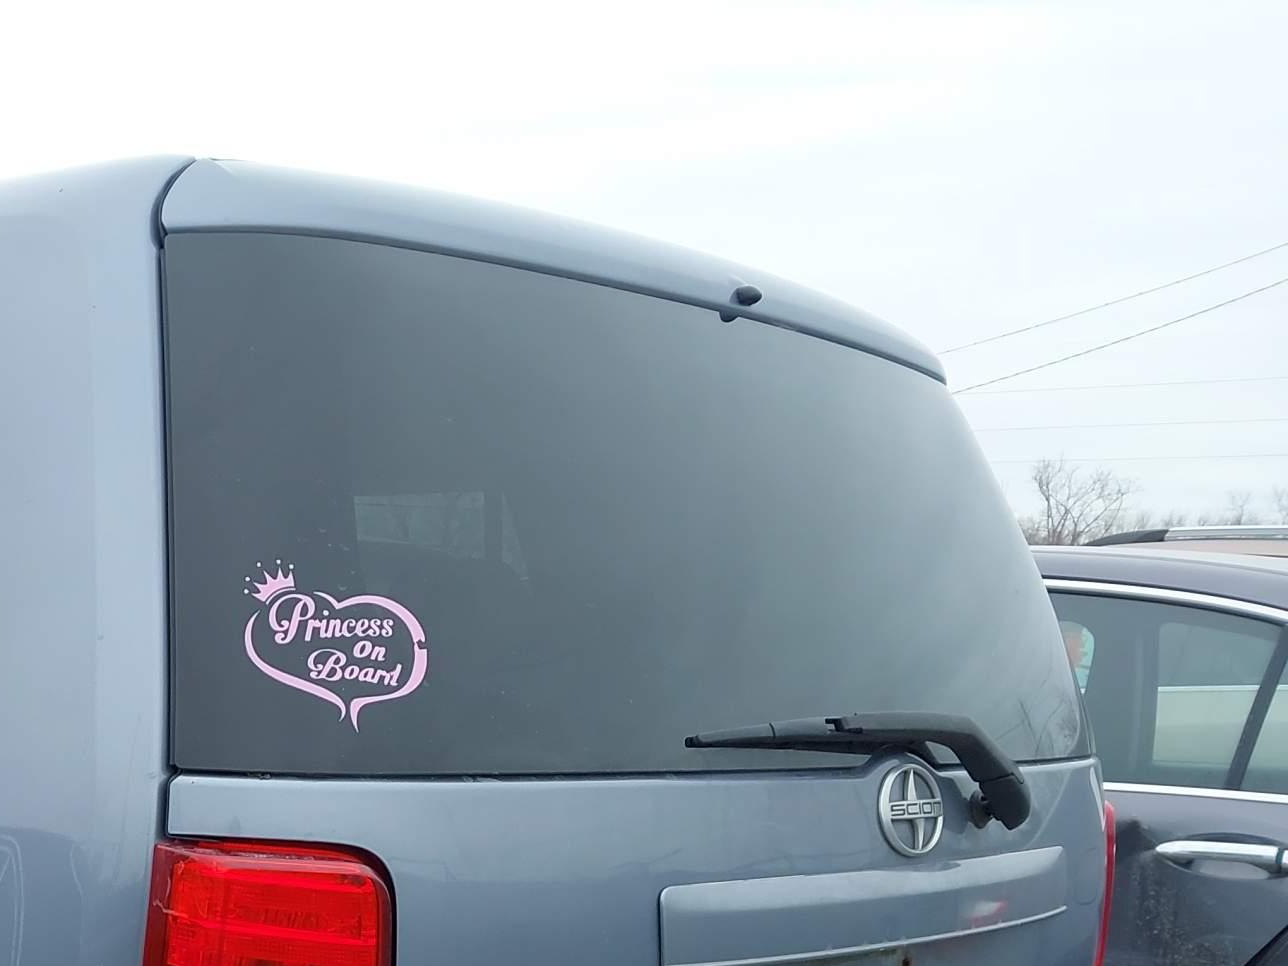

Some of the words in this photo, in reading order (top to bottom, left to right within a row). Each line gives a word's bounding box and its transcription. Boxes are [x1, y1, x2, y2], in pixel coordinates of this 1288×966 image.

[268, 593, 394, 644] Princess
[307, 648, 402, 686] Board
[353, 641, 386, 661] On
